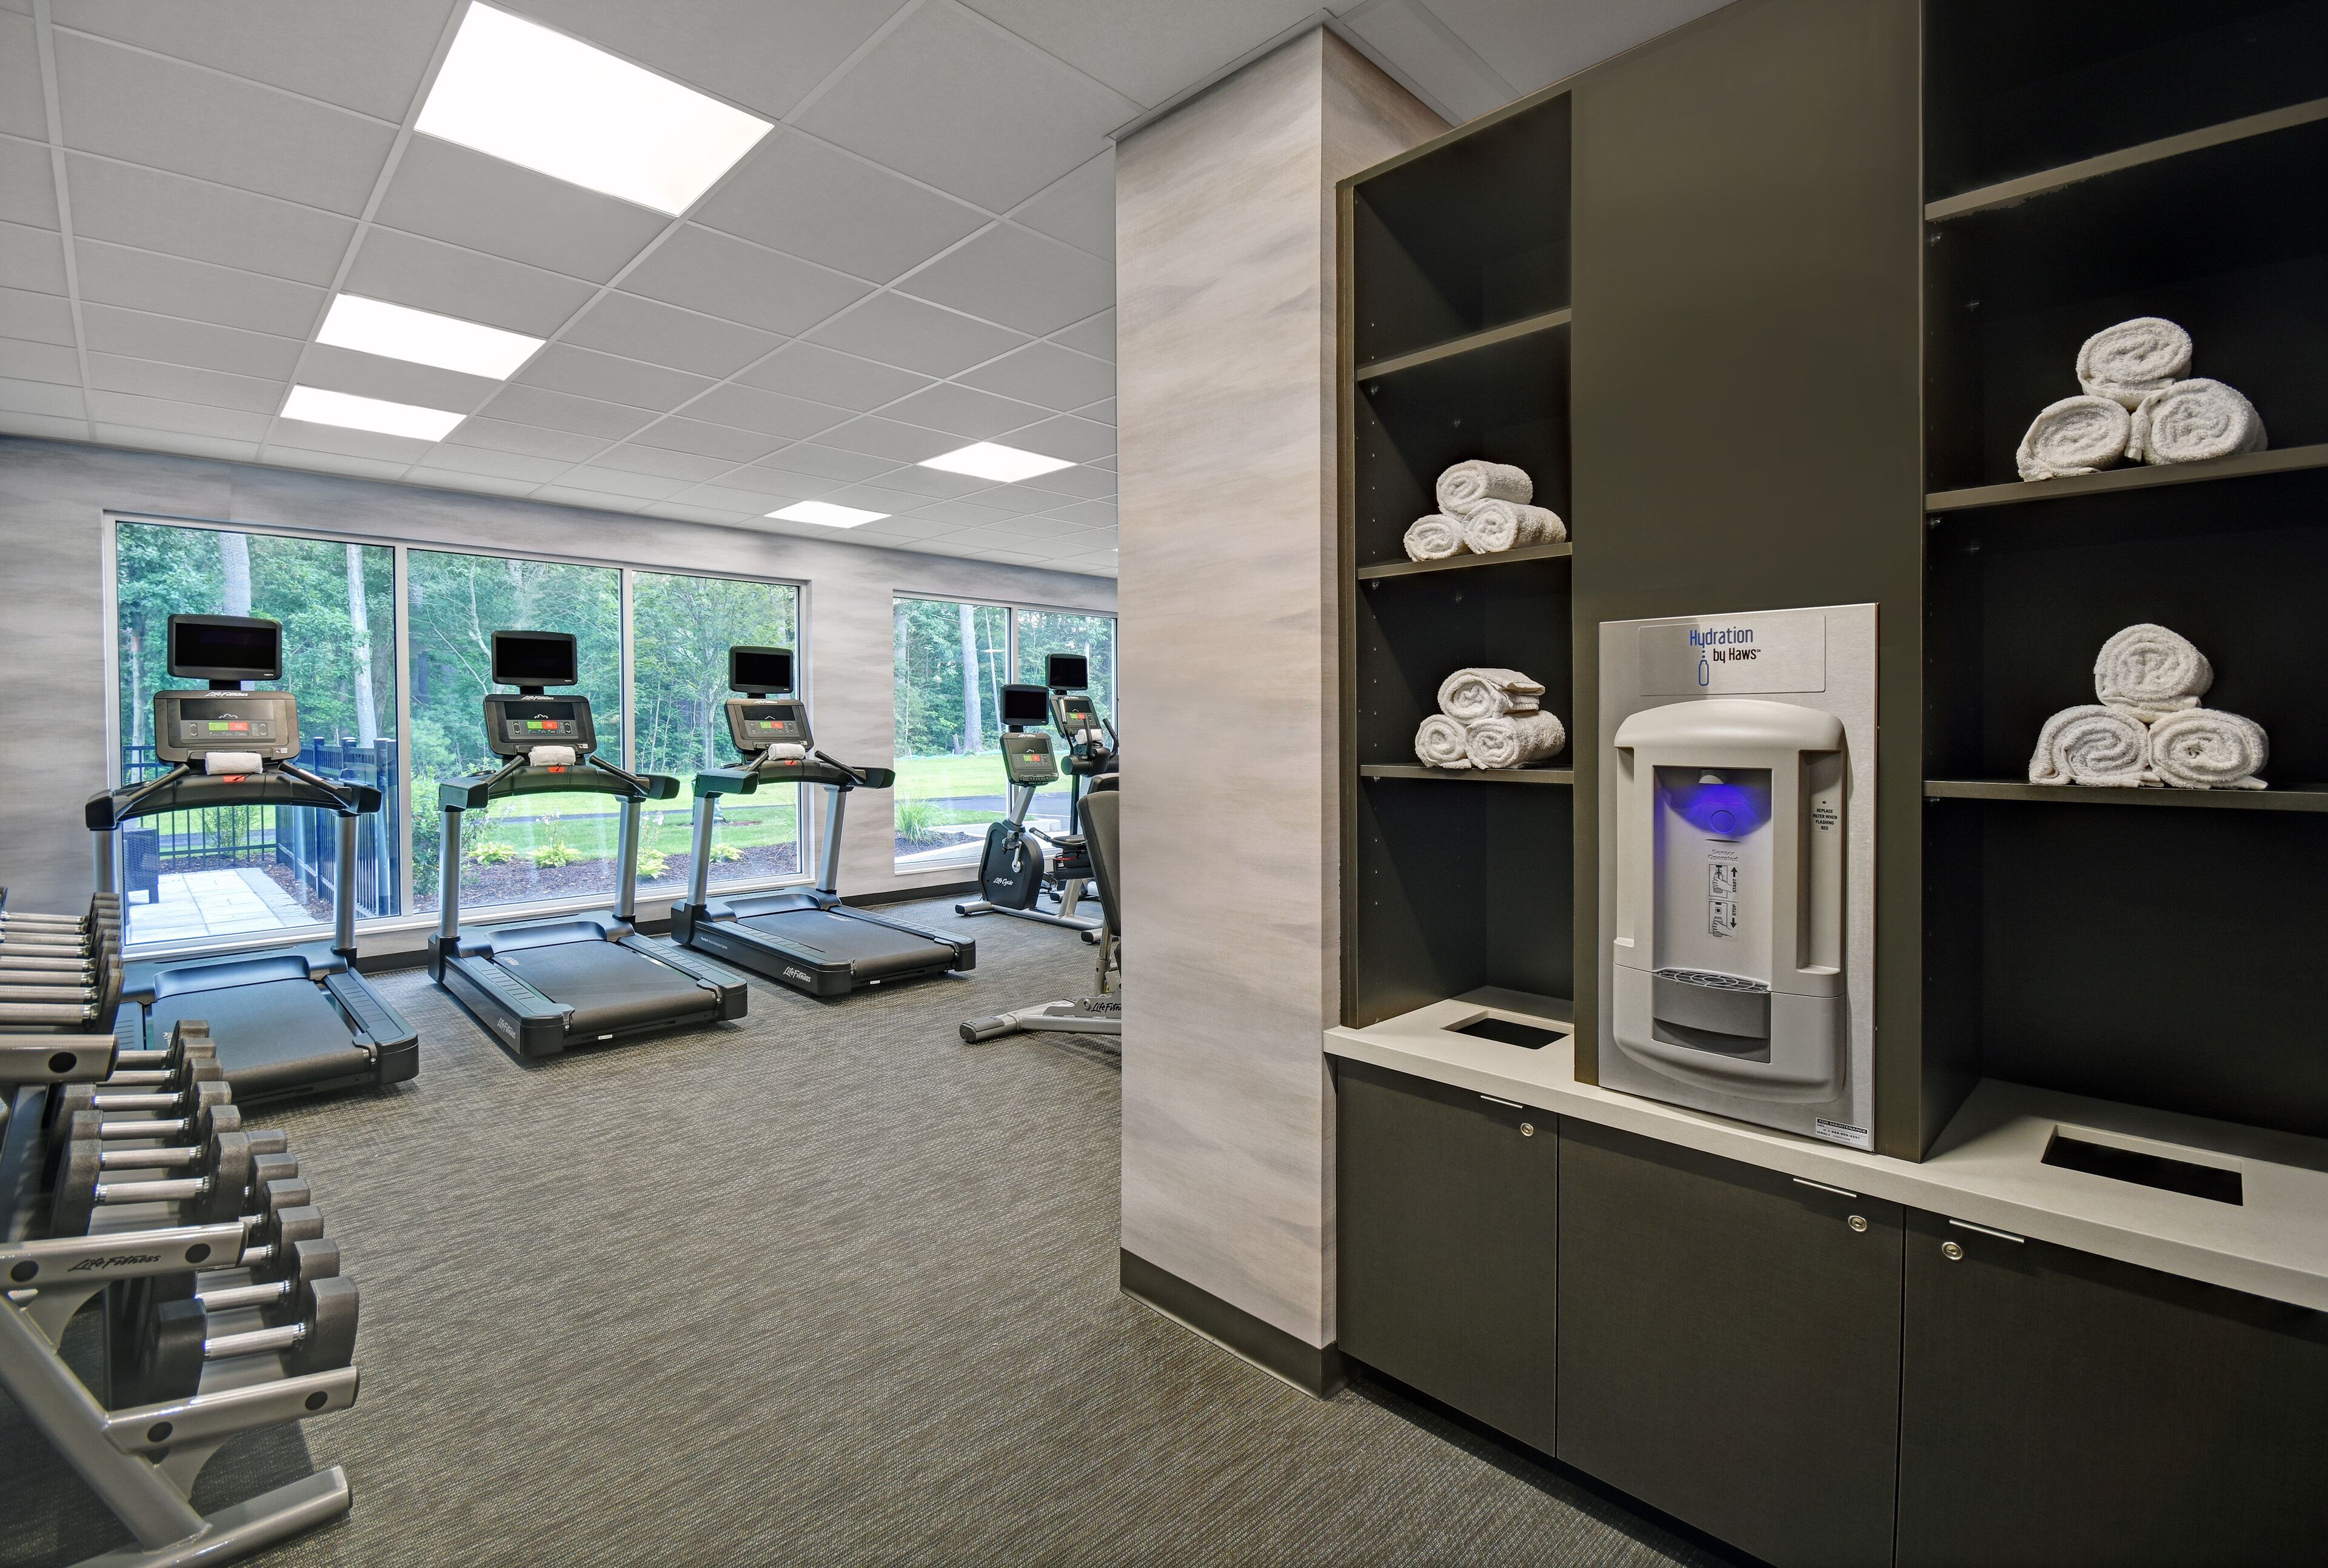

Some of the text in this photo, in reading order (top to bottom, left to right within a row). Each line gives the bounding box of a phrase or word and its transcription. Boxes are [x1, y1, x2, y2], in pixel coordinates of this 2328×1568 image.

[1690, 626, 1753, 649] Hydration
[1713, 648, 1725, 664] by
[1708, 854, 1739, 862] Operated
[1829, 1122, 1867, 1133] MAINTENANCE
